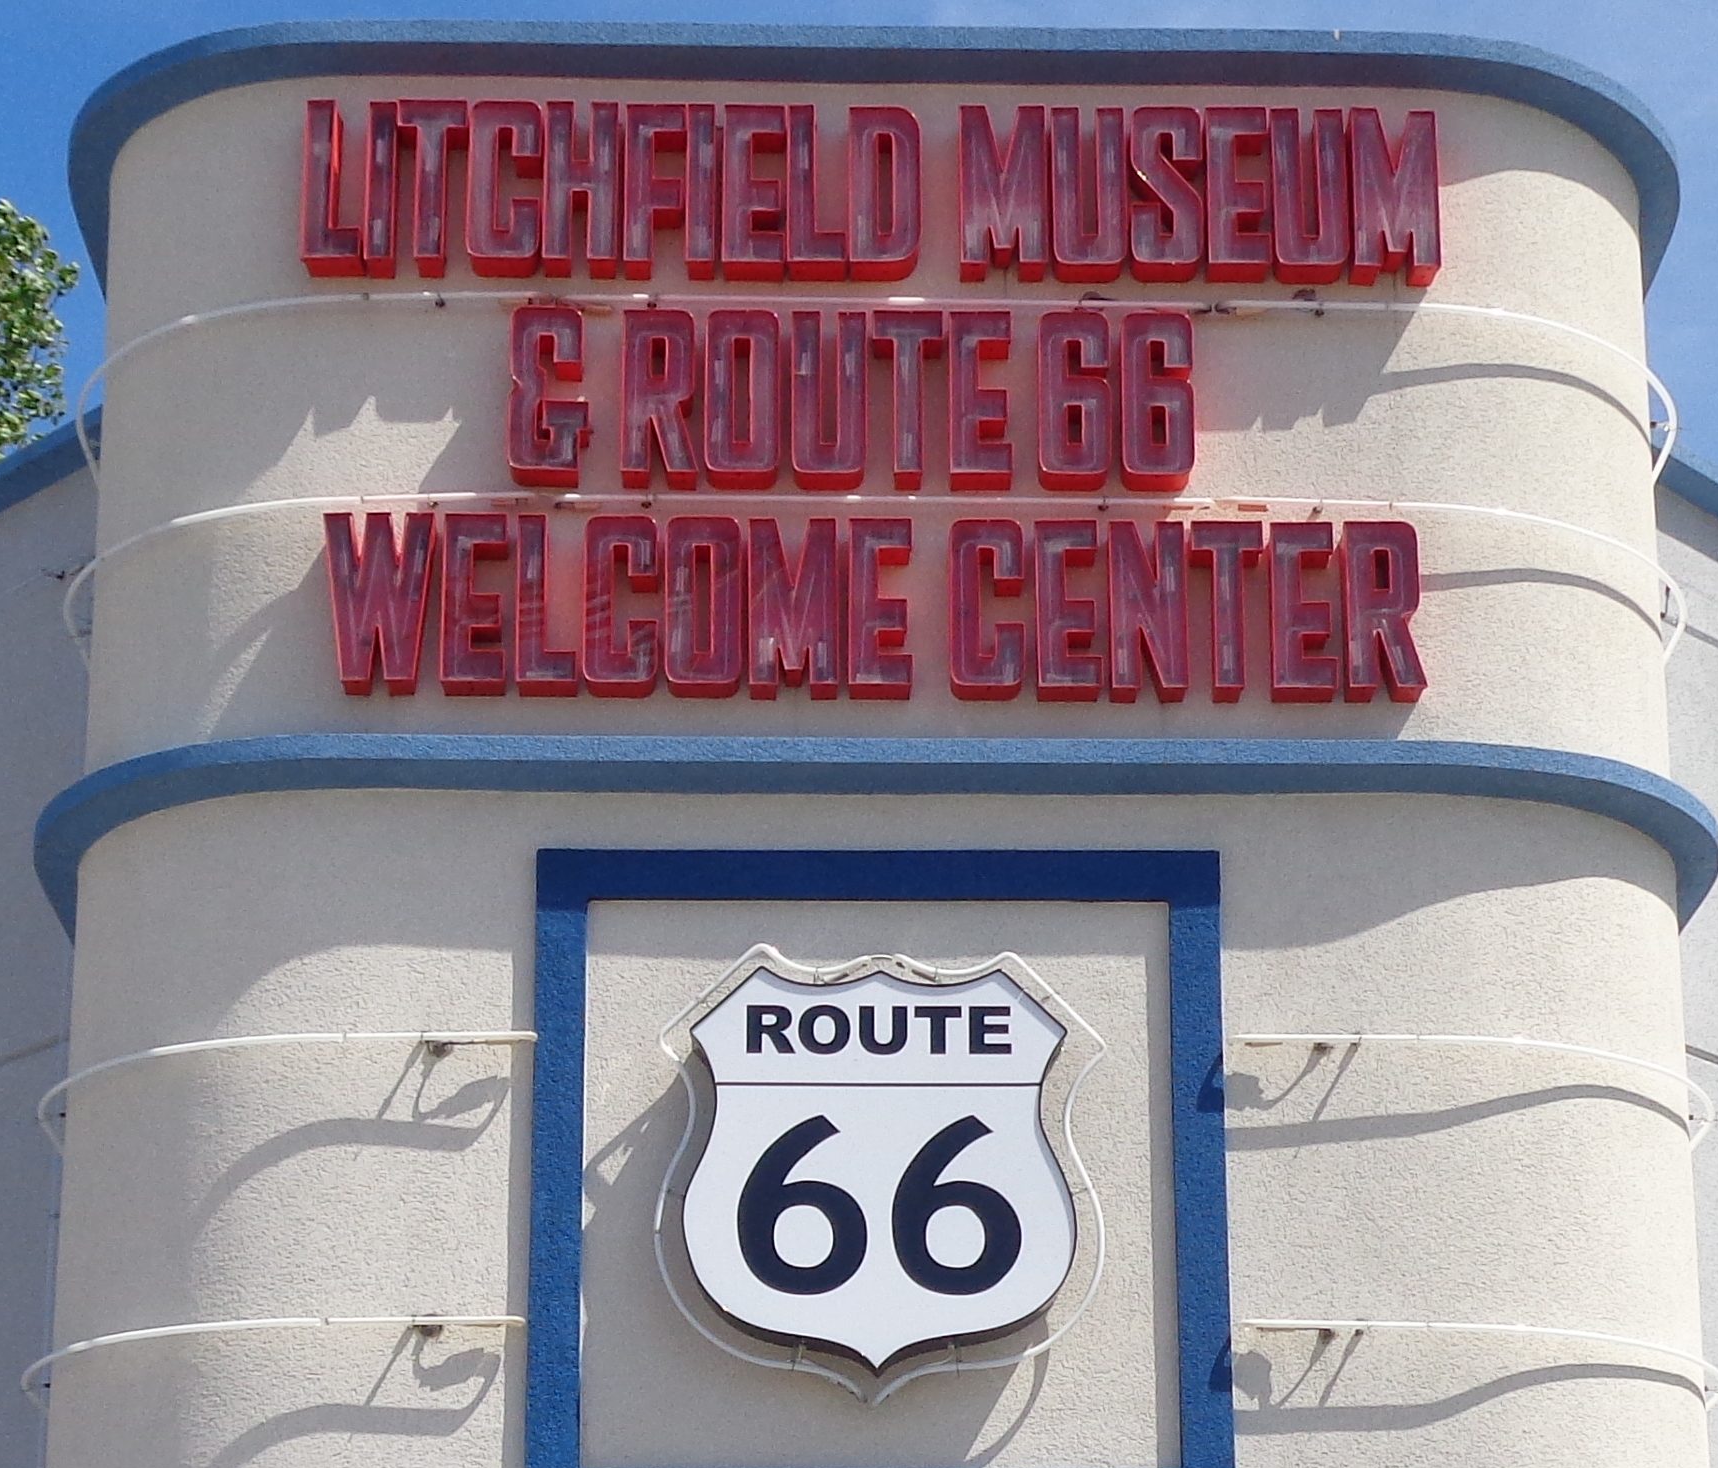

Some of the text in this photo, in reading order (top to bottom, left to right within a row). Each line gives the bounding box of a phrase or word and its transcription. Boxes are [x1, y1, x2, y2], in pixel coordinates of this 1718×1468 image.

[301, 98, 1442, 286] LITCHFIELD MUSEUM
[507, 305, 1194, 491] & ROUTE 66
[324, 512, 1428, 703] WELCOME CENTER
[745, 1004, 1013, 1055] ROUTE
[737, 1115, 1023, 1296] 66
